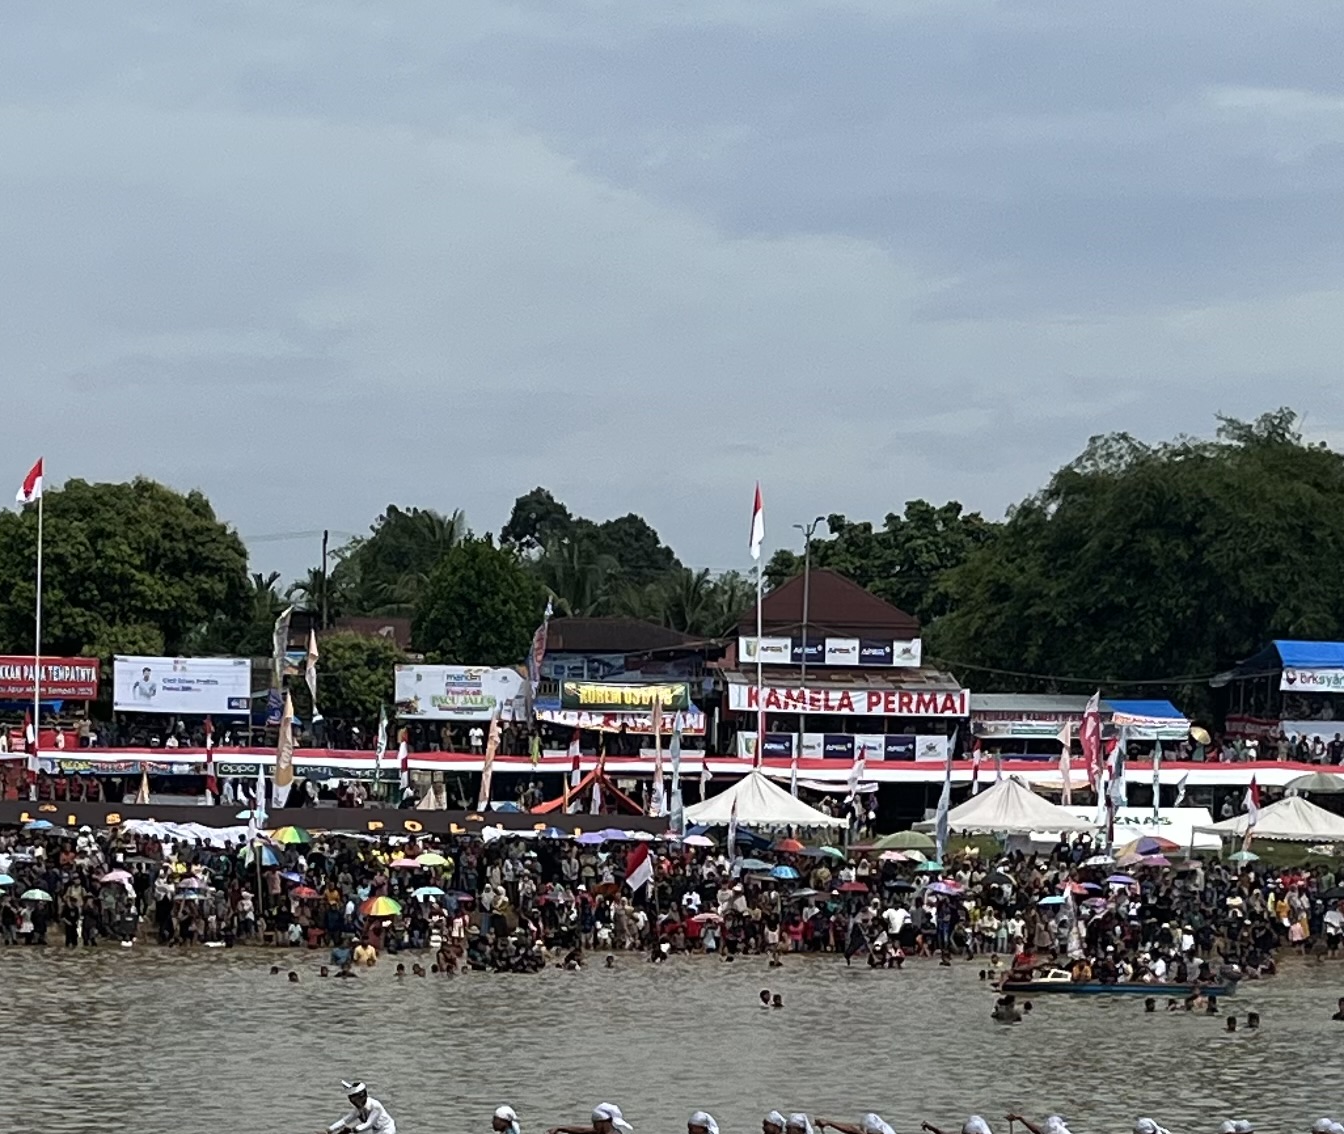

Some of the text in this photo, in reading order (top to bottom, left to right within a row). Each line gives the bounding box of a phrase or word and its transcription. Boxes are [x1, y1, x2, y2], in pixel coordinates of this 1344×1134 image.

[48, 665, 97, 682] TEMPATNYA
[747, 686, 965, 714] KAMELA PERMAI
